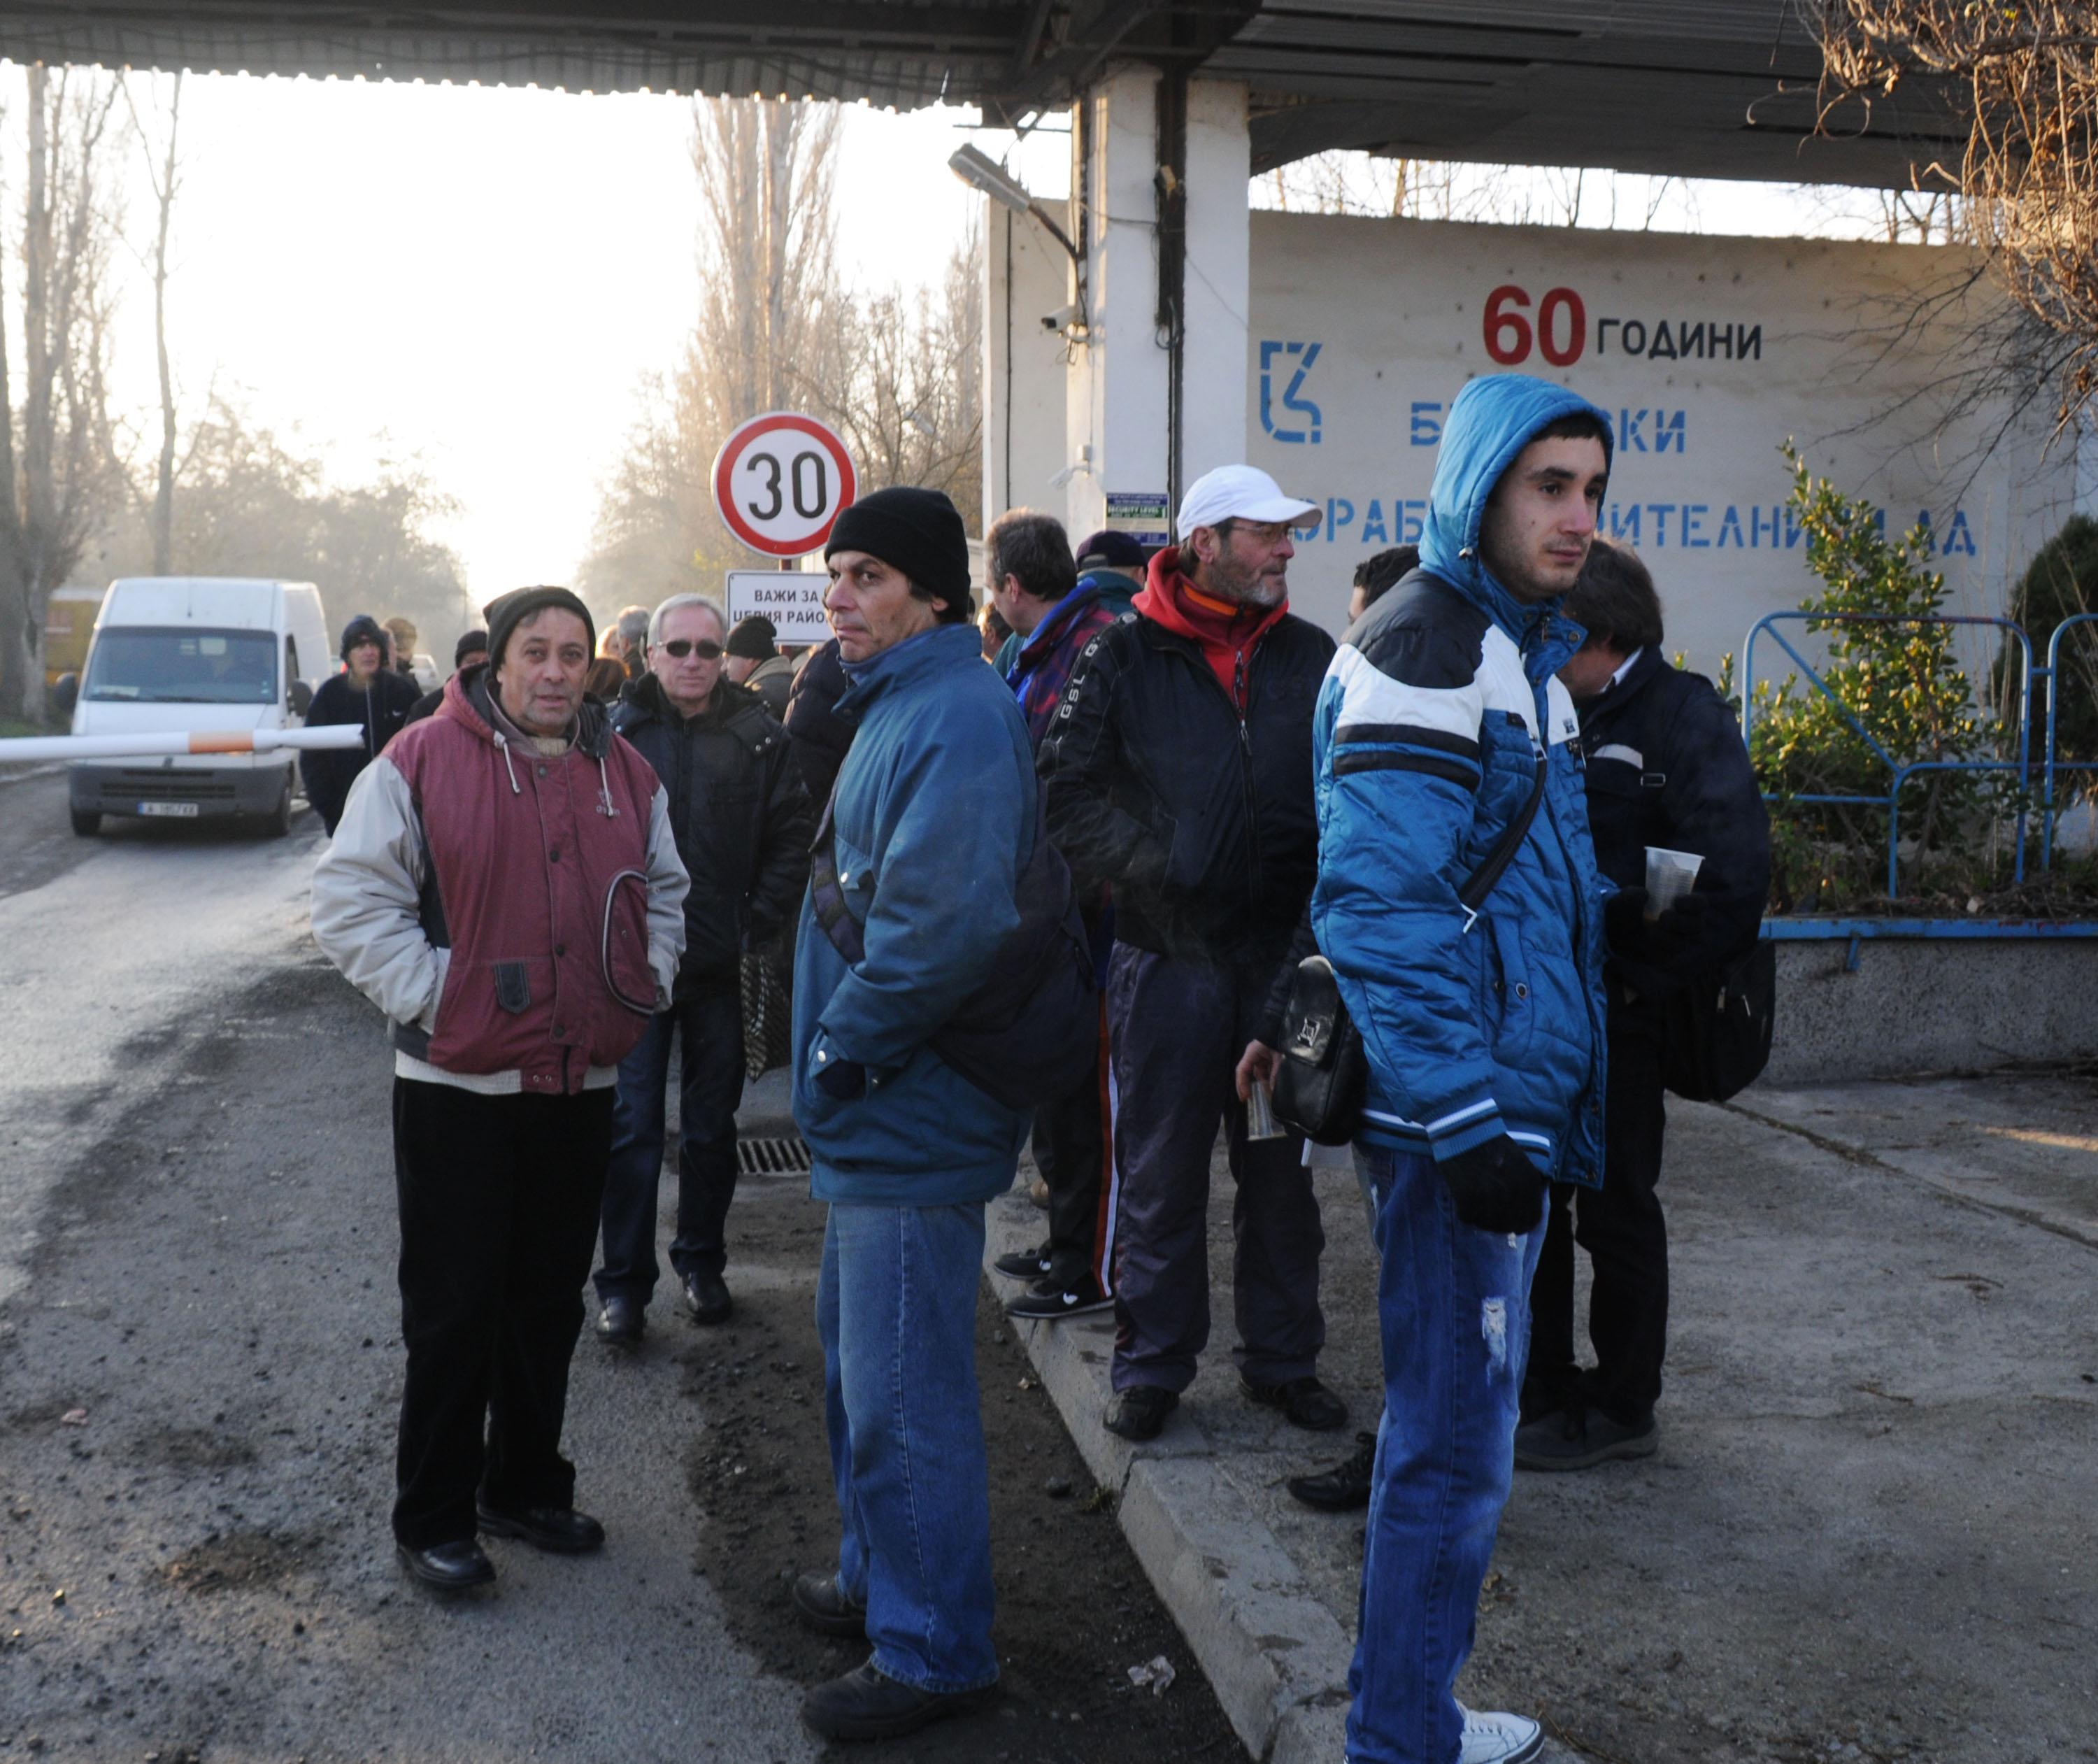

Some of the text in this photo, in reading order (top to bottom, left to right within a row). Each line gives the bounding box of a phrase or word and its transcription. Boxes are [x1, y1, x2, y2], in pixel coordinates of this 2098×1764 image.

[1483, 284, 1762, 367] 60 ГОДИНИ
[747, 451, 827, 520] 30
[755, 590, 818, 602] ВАЖИ ЗА
[787, 609, 828, 623] РАЙО
